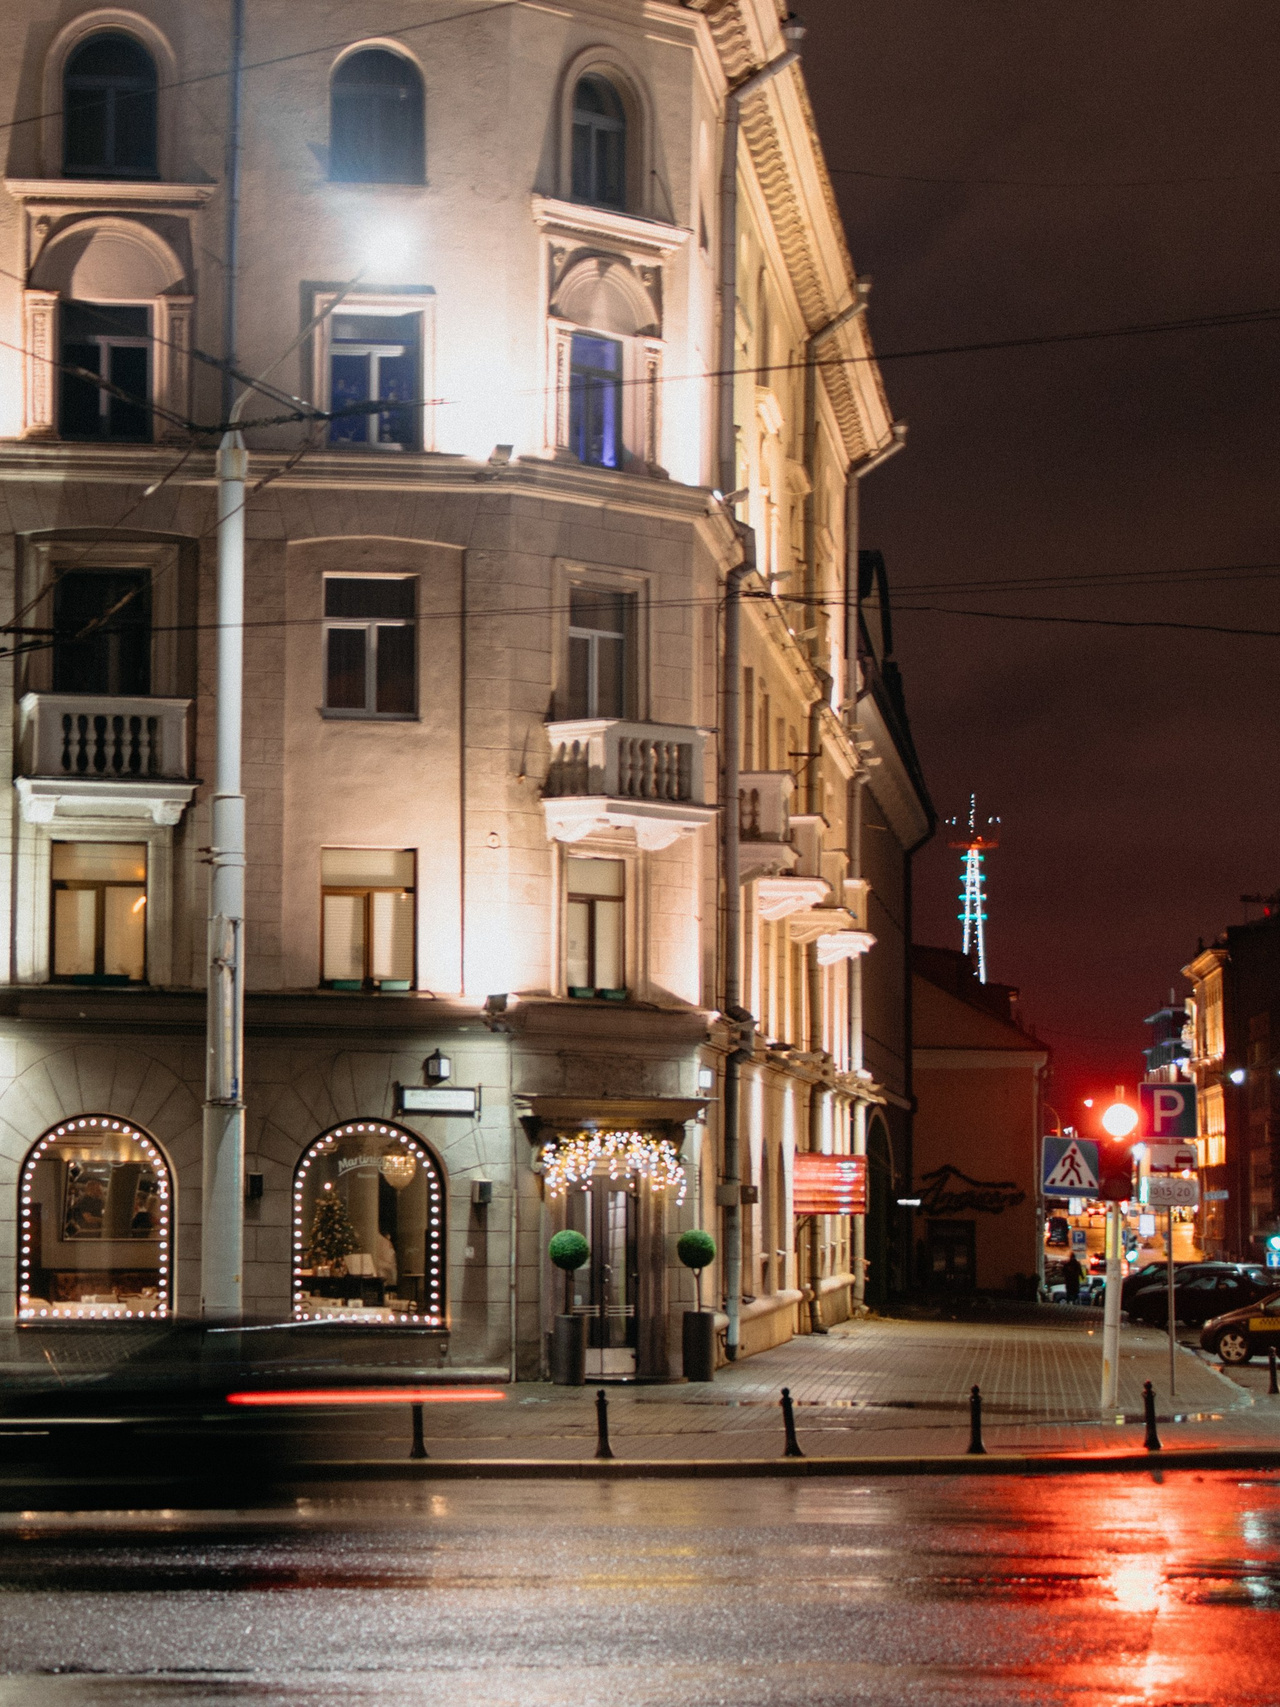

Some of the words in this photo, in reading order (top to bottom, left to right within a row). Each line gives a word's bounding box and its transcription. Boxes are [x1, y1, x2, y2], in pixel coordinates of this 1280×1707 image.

[1153, 1089, 1185, 1133] P
[1162, 1187, 1172, 1196] 15
[1177, 1187, 1191, 1197] 20
[1074, 1231, 1084, 1242] P
